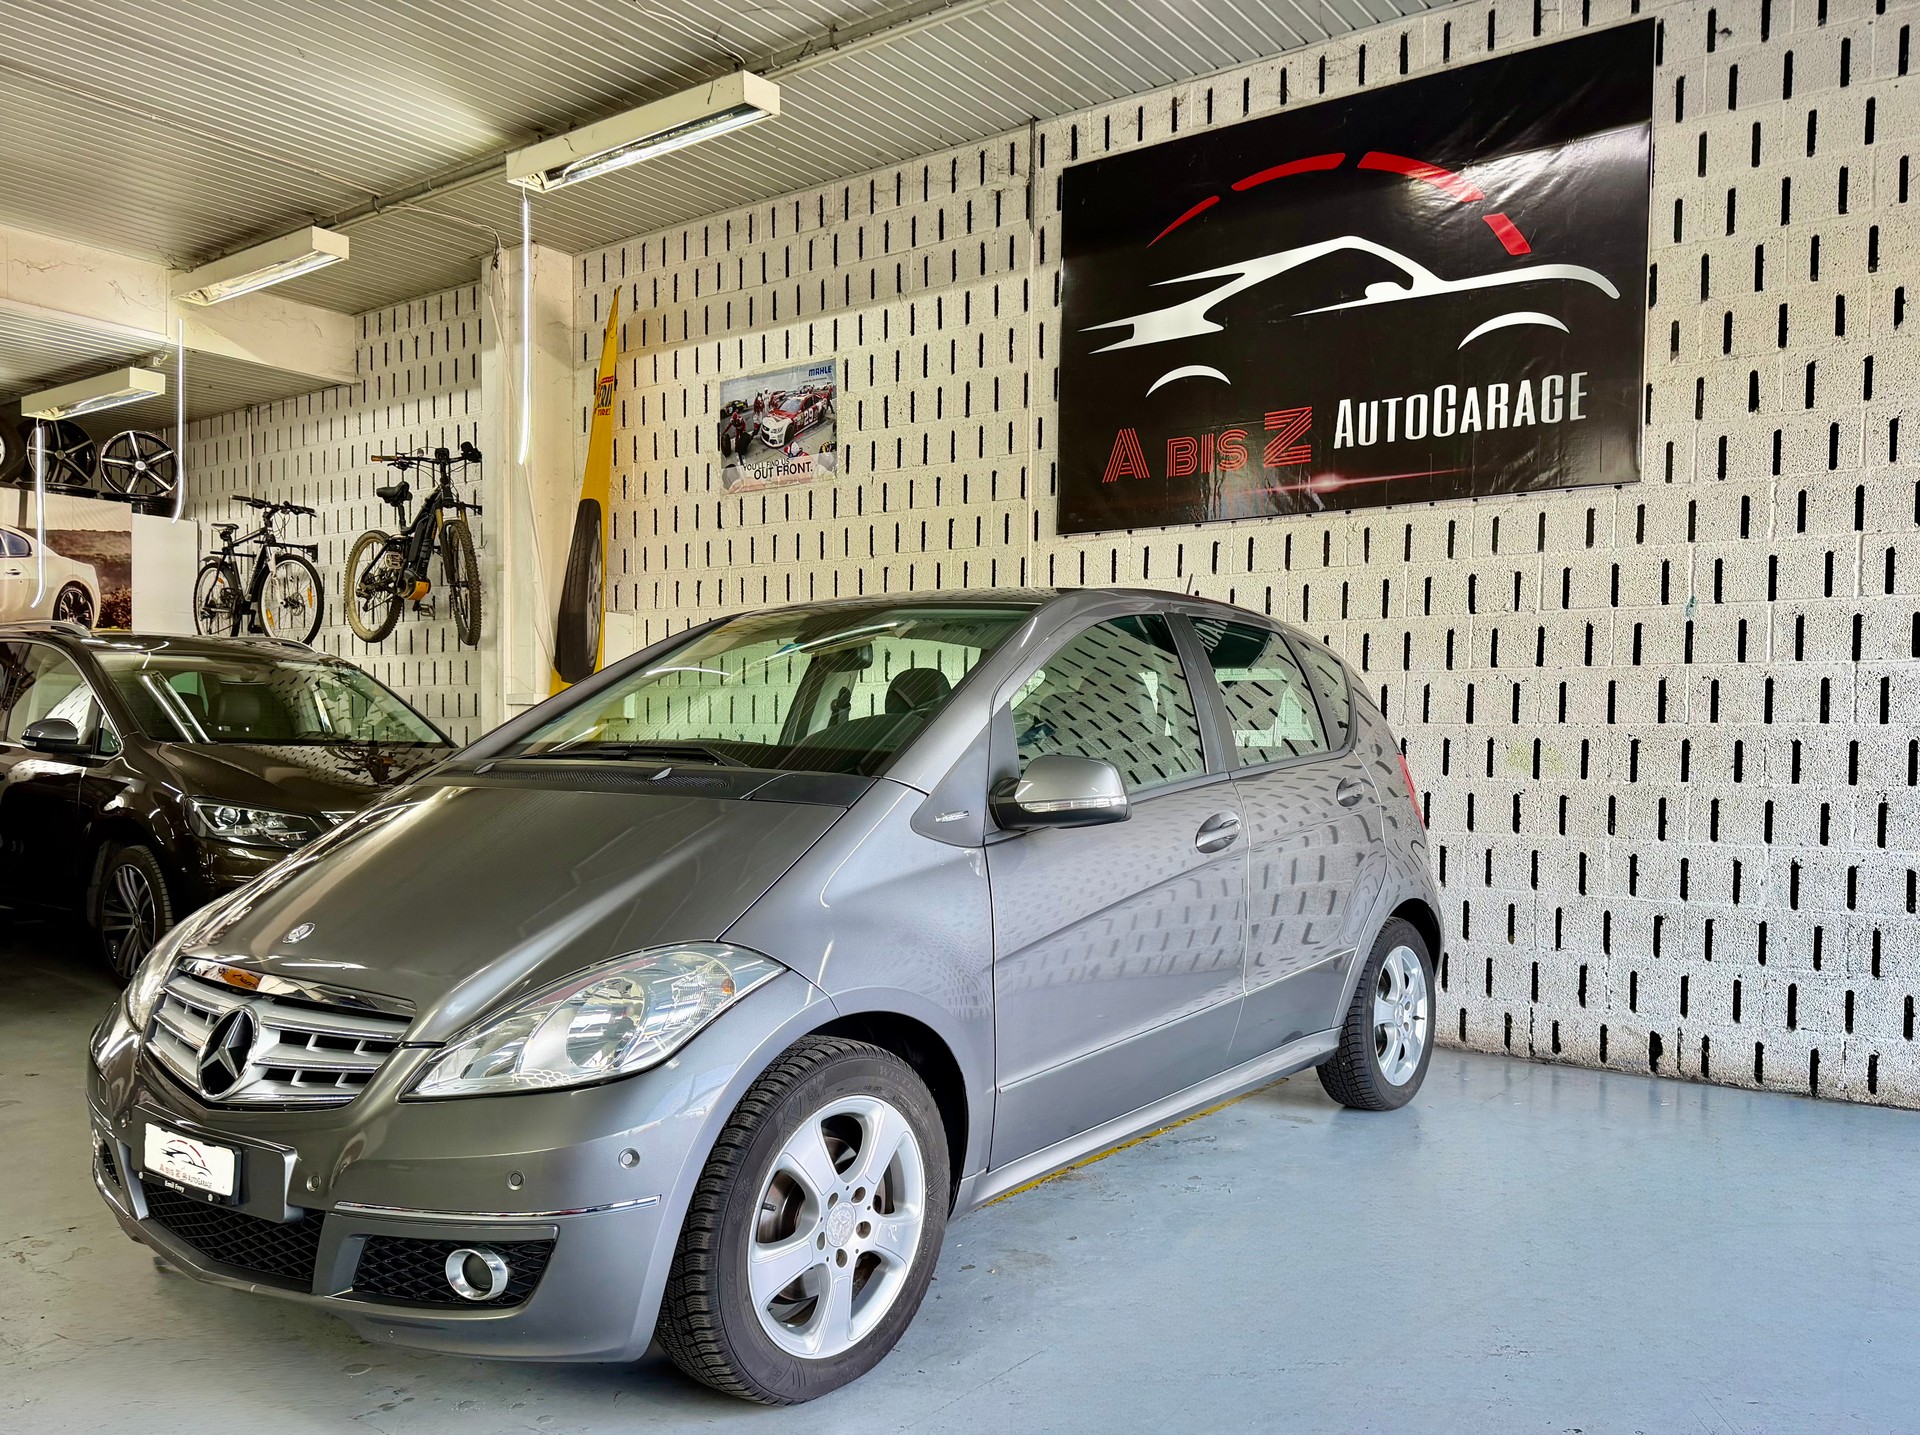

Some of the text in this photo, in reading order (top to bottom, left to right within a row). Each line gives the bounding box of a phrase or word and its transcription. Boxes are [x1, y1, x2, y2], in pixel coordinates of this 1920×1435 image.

[808, 365, 832, 377] MAHLE
[804, 408, 814, 425] 29
[1102, 427, 1150, 483] A
[1167, 429, 1249, 478] BIS
[1263, 406, 1313, 468] Z
[753, 461, 813, 480] OUT FRONT.
[767, 459, 780, 467] FIND
[781, 457, 790, 466] US
